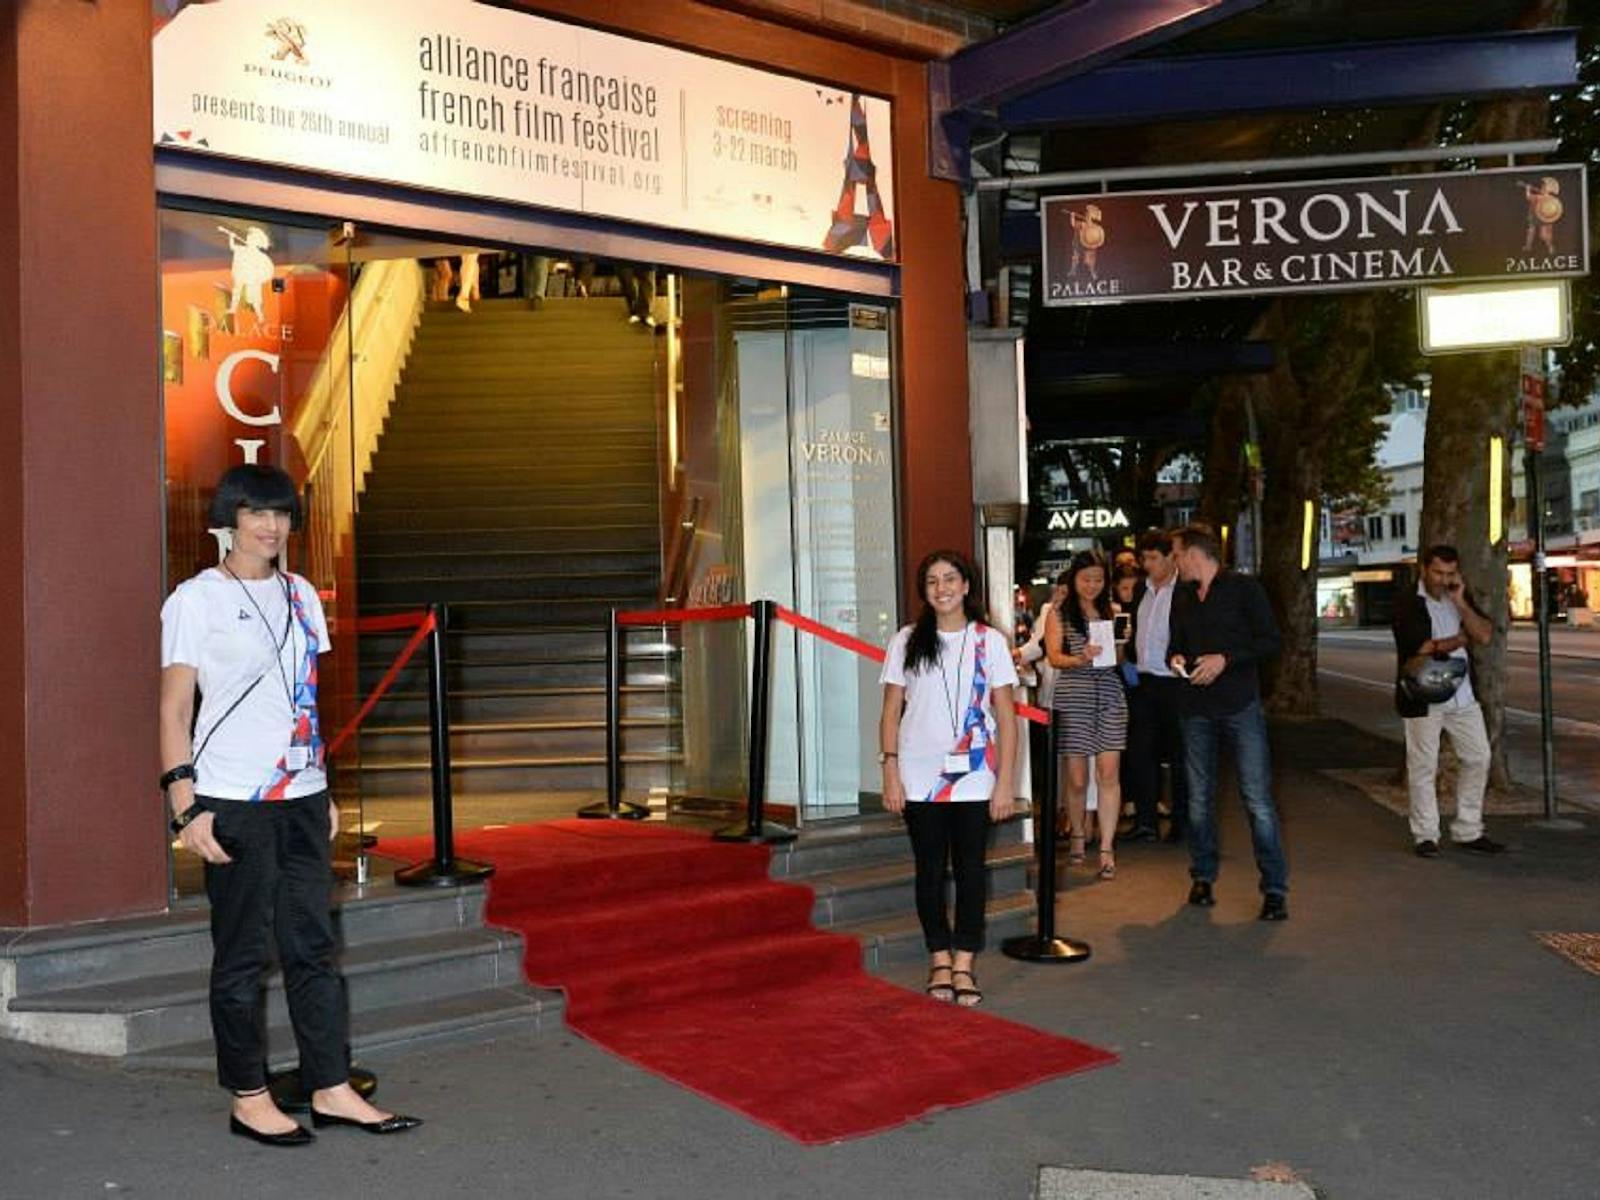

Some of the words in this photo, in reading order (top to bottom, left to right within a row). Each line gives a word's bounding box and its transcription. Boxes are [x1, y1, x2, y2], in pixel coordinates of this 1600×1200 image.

[243, 62, 334, 88] PEUGEOT
[419, 34, 529, 92] alliance
[537, 57, 657, 119] française
[192, 92, 265, 124] presents
[270, 104, 295, 129] the
[339, 119, 390, 145] annual
[418, 80, 504, 134] french
[514, 100, 564, 145] film
[572, 112, 660, 163] festival
[716, 104, 792, 145] screening
[418, 131, 664, 195] affrenchfilmfestival.org
[749, 142, 798, 172] march
[1147, 187, 1464, 250] VERONA
[1171, 260, 1248, 290] BAR
[1252, 261, 1274, 282] &
[1280, 246, 1455, 282] CINEMA
[1505, 255, 1579, 272] PALACE
[1052, 279, 1119, 297] PALACE
[801, 442, 888, 466] VERONA
[1047, 507, 1130, 530] AVEDA
